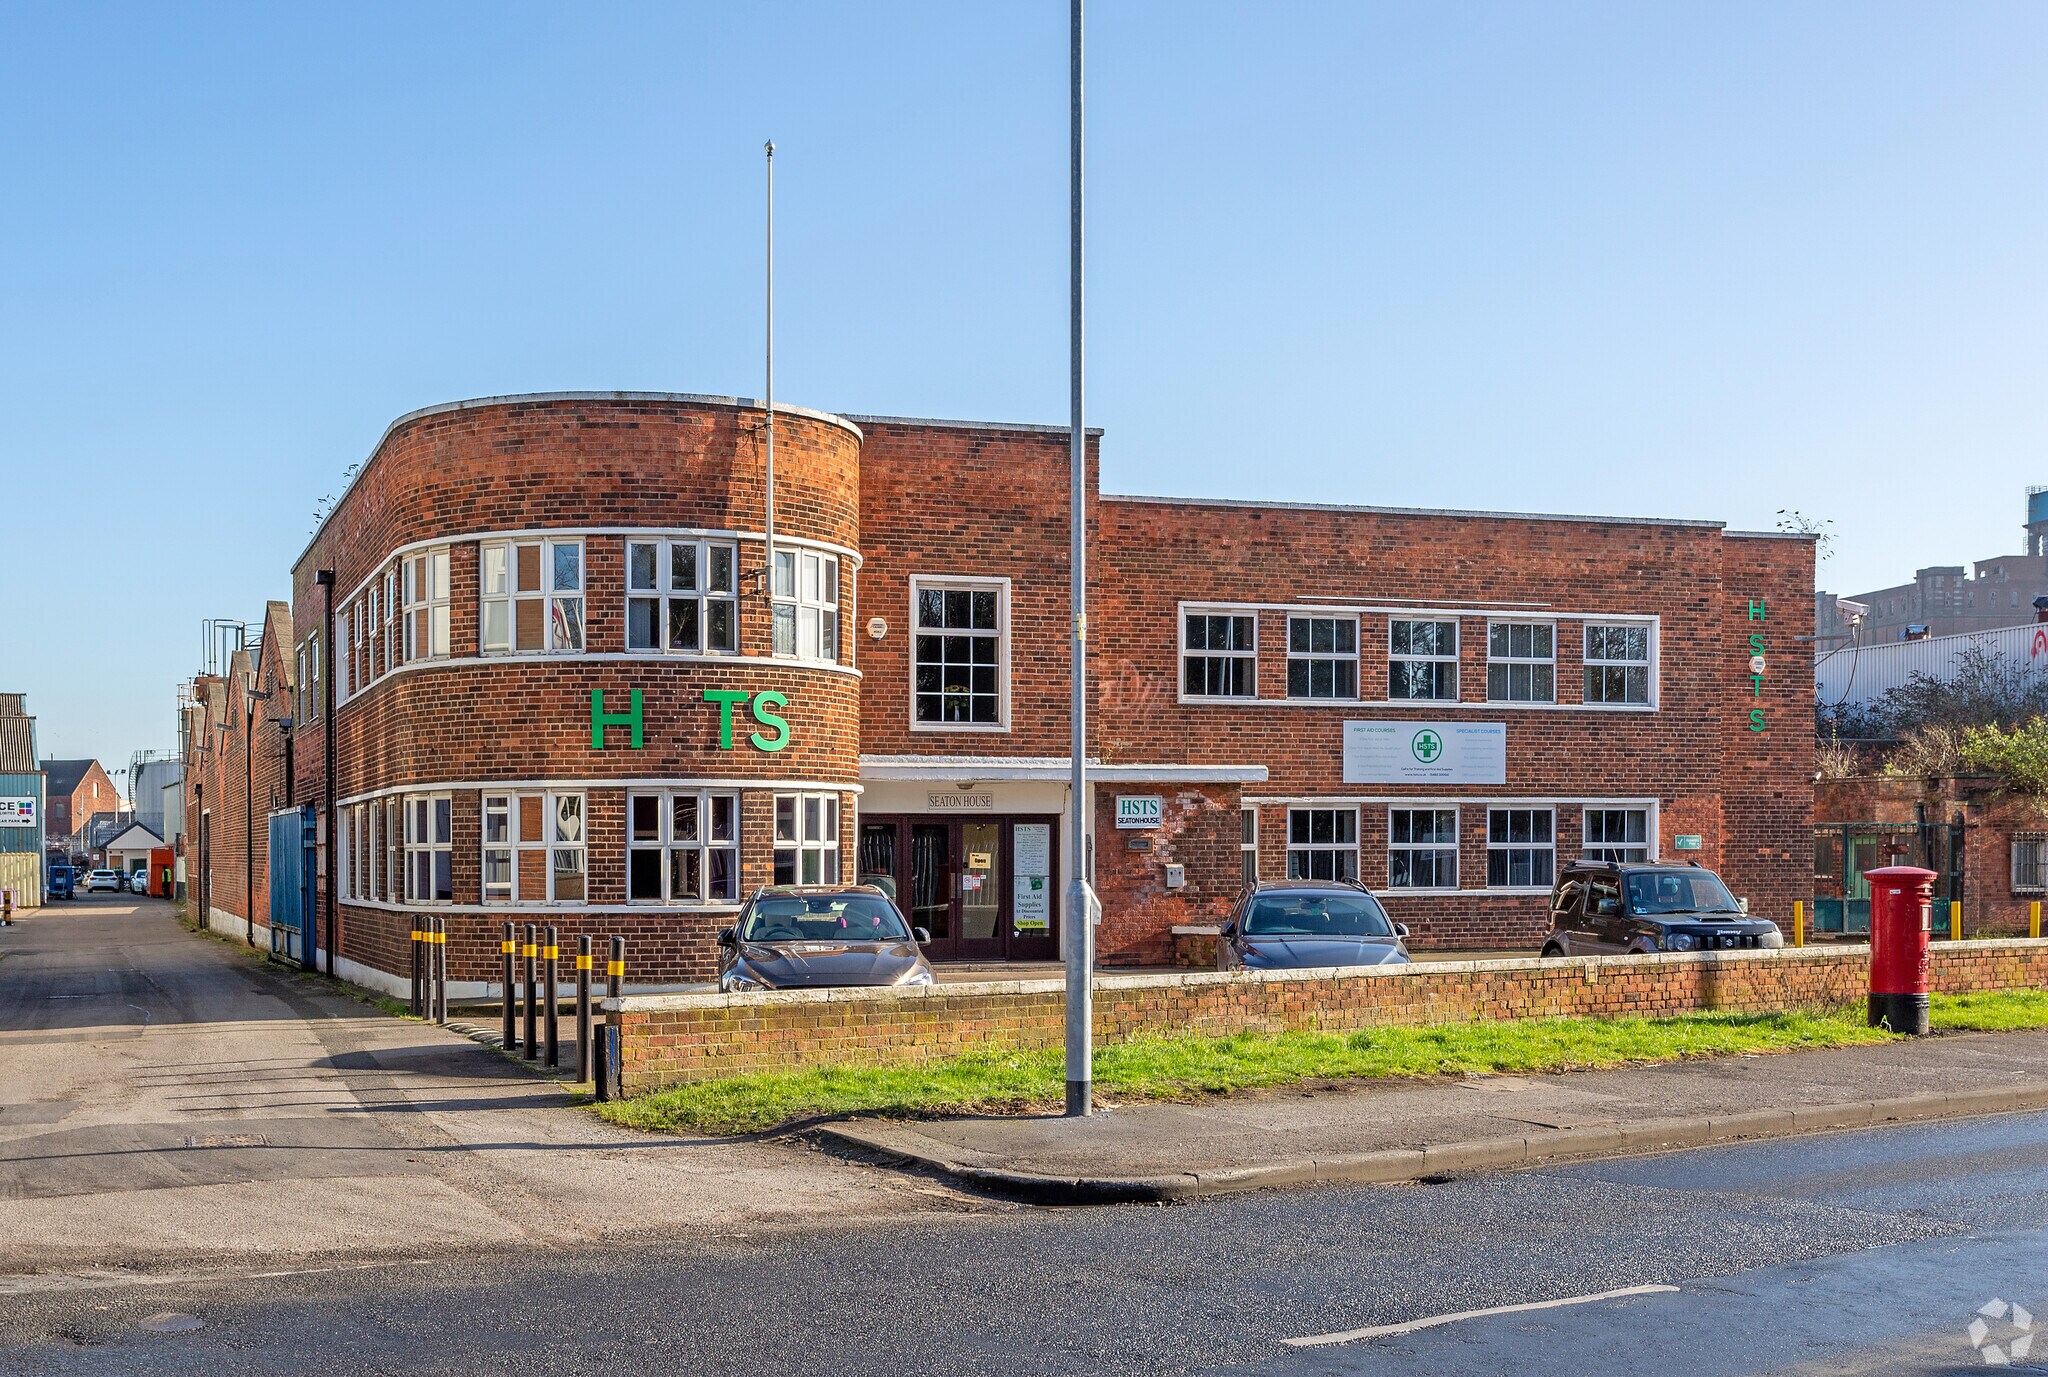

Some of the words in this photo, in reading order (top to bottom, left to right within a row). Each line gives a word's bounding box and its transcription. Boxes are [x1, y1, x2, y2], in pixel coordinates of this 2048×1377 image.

[930, 795, 962, 807] SEATON
[963, 795, 991, 807] HOUSE
[1121, 799, 1158, 815] HSTS
